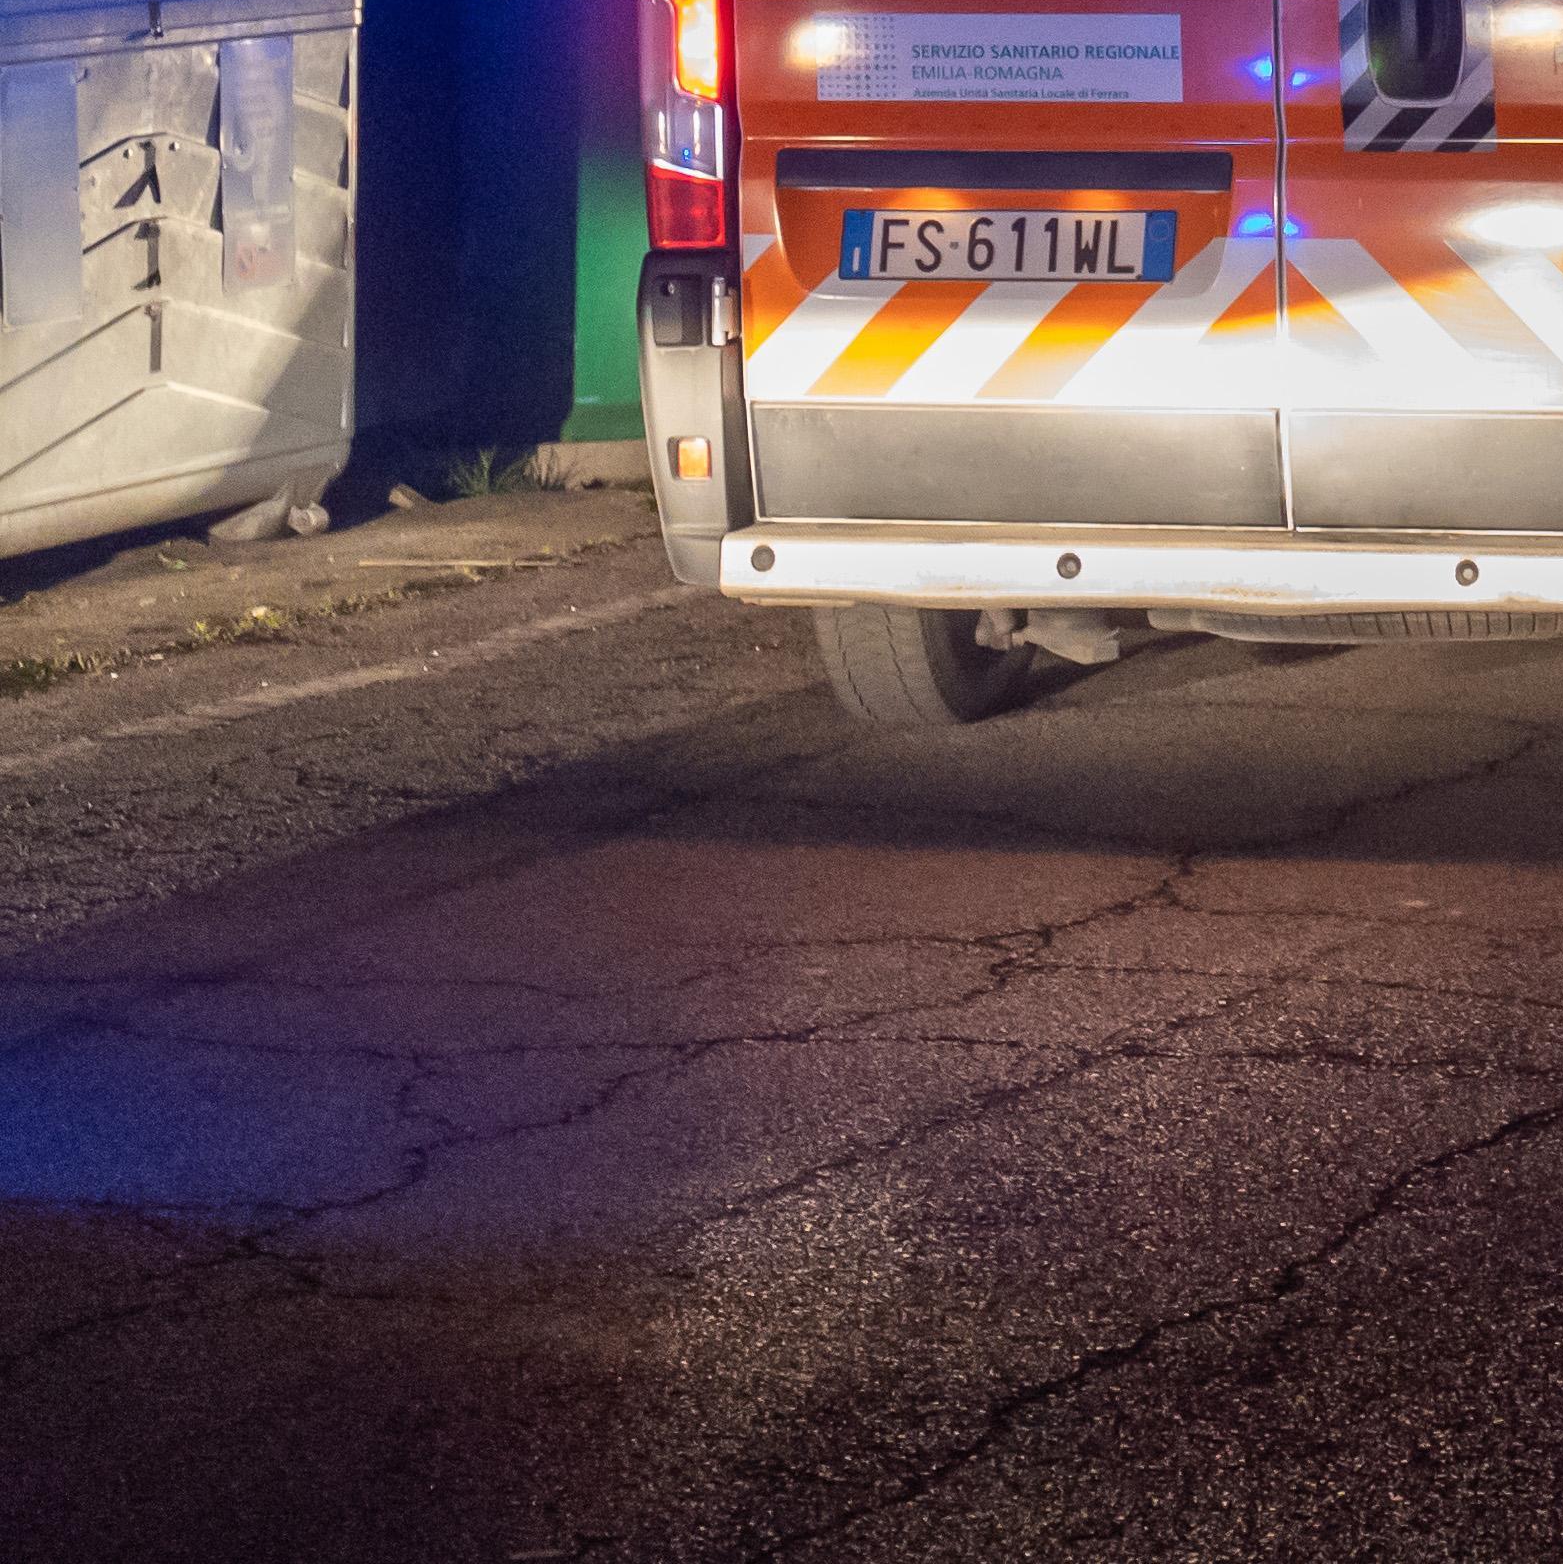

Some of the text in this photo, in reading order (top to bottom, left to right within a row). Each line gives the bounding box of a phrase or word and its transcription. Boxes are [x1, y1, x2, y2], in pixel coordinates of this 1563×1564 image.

[911, 44, 1180, 61] SERVIZIO SANITARIO REGIONALE
[913, 88, 957, 100] Azienda
[991, 88, 1038, 100] Sanitaria
[1041, 89, 1076, 100] Locale
[1077, 88, 1089, 100] di
[1091, 89, 1130, 101] Ferrara
